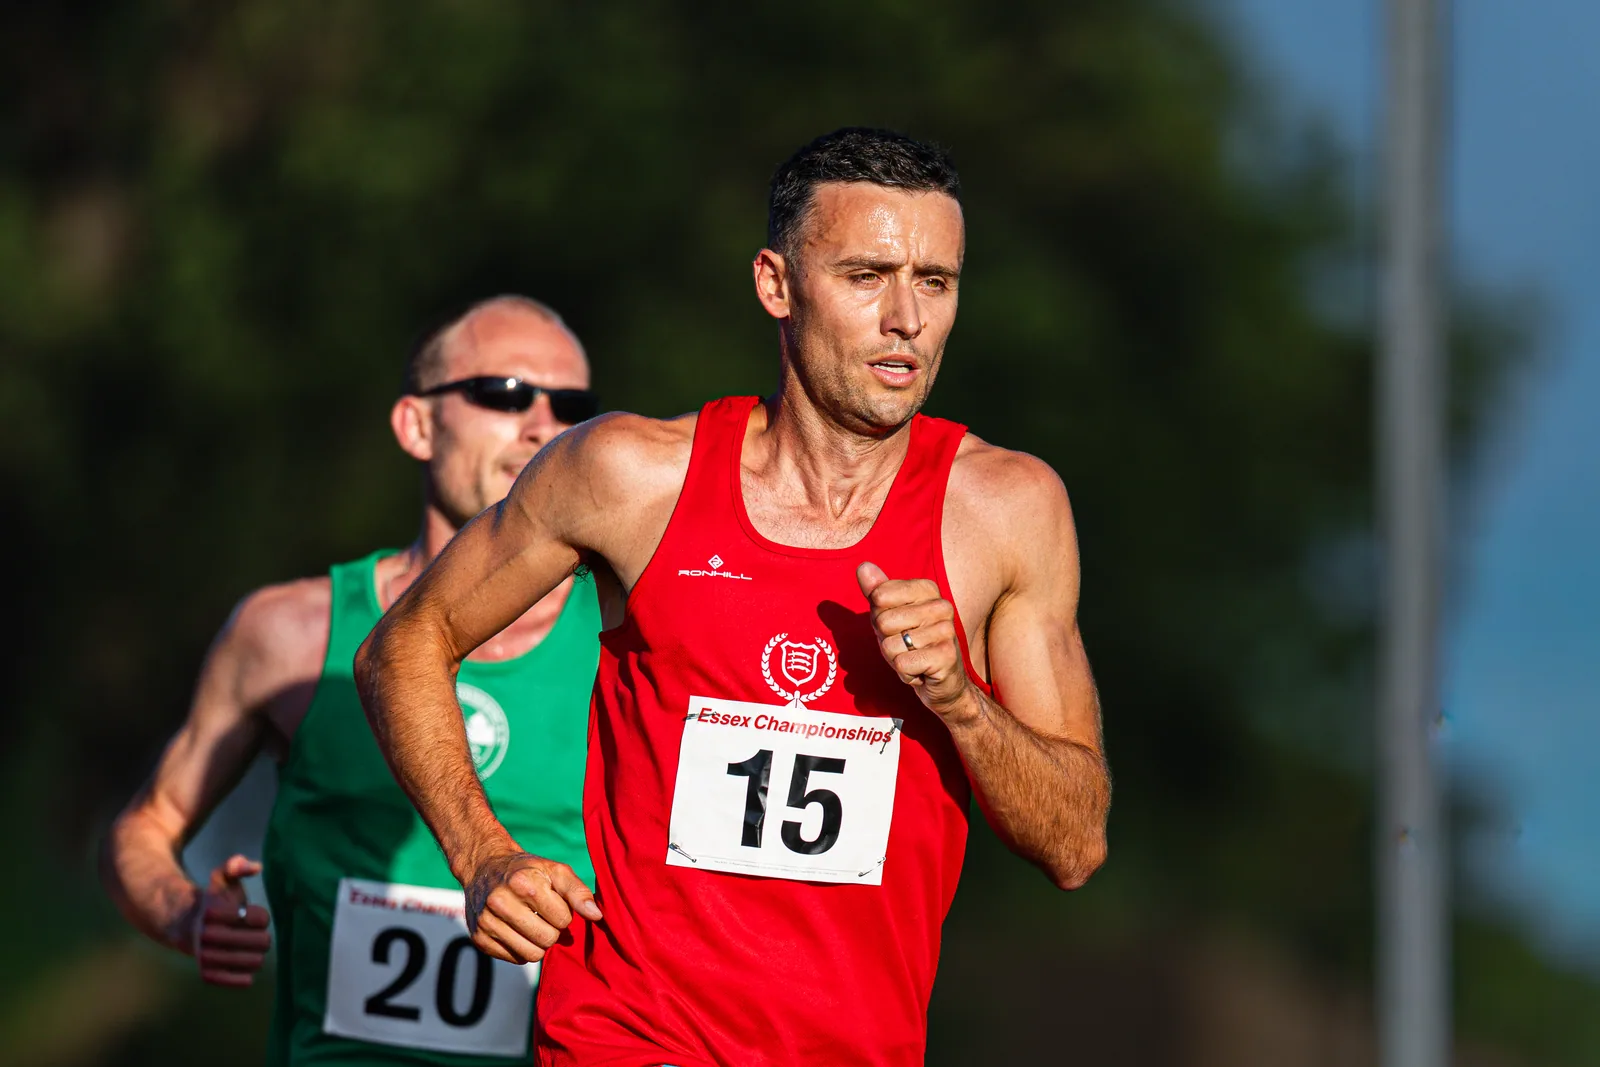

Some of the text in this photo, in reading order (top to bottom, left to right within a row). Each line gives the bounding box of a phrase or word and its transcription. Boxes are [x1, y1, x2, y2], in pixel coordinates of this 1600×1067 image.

[678, 569, 753, 581] RONHILL
[698, 707, 893, 745] Essex Championships
[727, 748, 846, 856] 15
[364, 926, 495, 1028] 20
